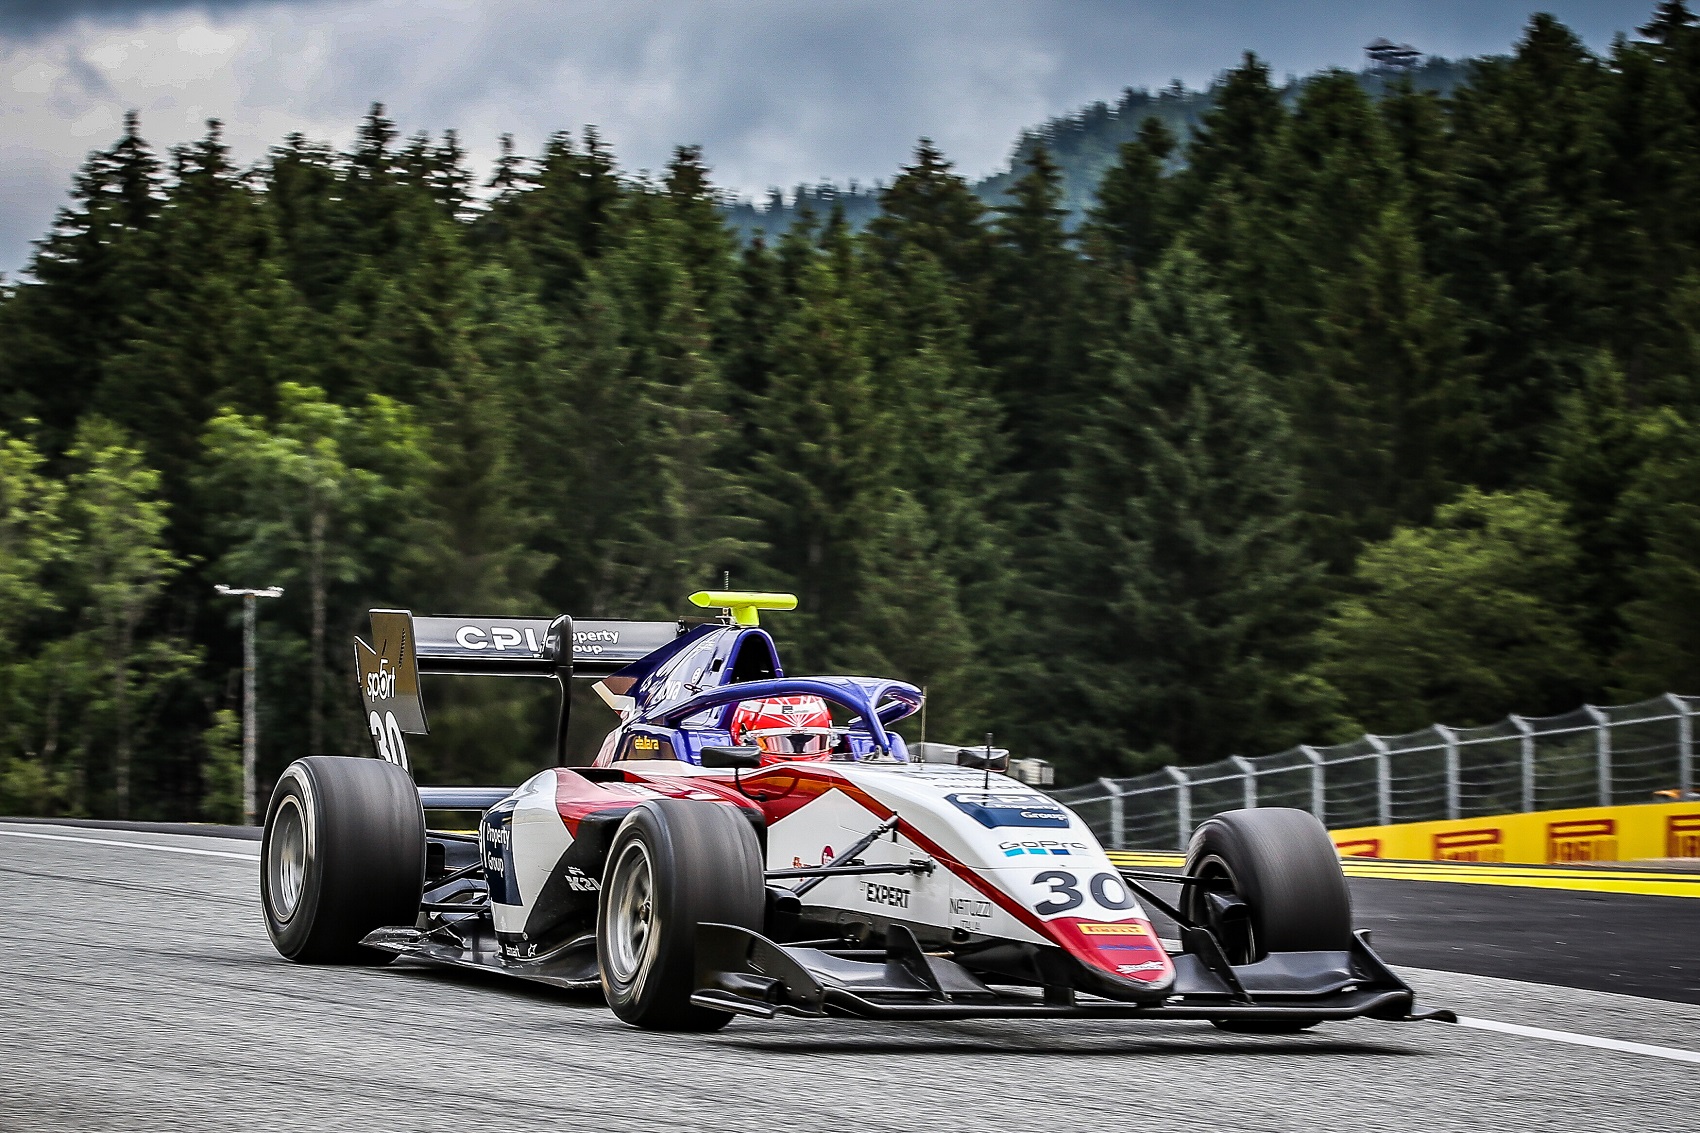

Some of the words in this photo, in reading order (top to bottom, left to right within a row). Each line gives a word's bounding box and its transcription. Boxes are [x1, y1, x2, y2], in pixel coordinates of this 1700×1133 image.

[456, 625, 540, 652] CPI
[572, 630, 620, 645] perty
[572, 645, 604, 655] oup
[369, 710, 409, 774] 30
[1020, 811, 1068, 821] Group
[486, 822, 511, 851] Property
[487, 850, 505, 878] Group
[1031, 870, 1135, 915] 30
